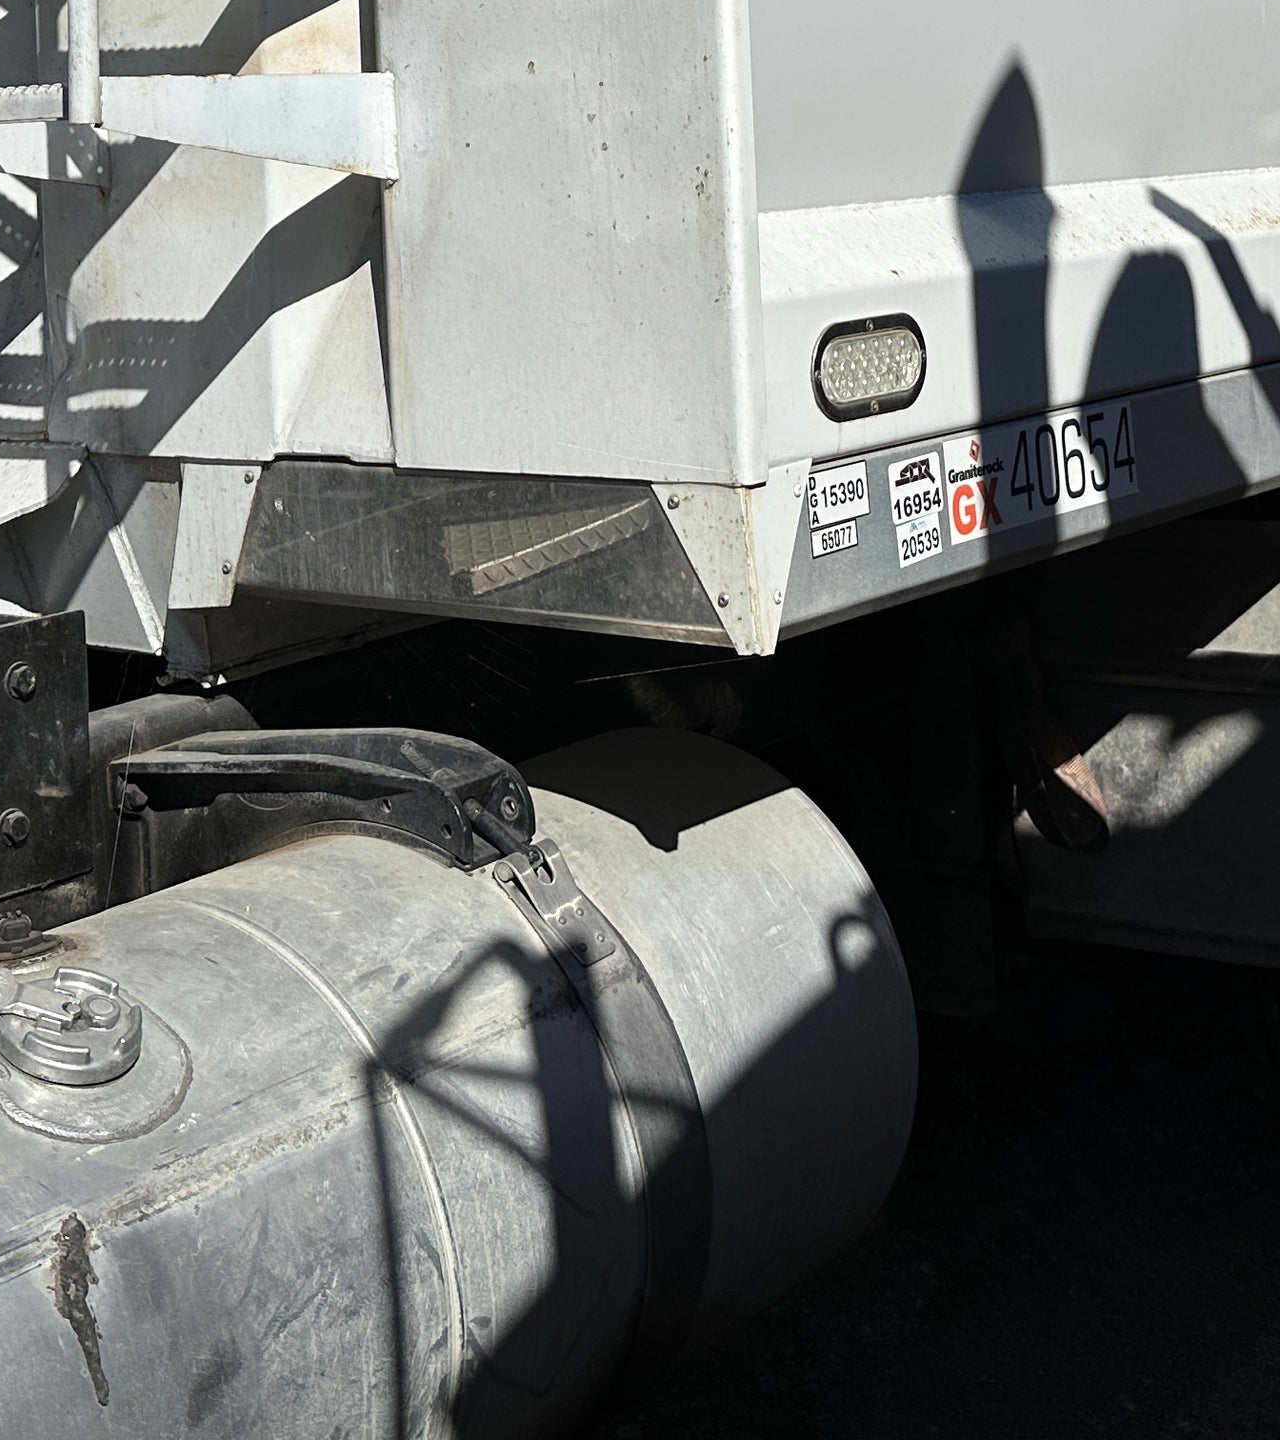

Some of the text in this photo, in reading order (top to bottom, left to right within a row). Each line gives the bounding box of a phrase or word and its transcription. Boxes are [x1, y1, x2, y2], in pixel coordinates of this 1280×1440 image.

[948, 457, 1004, 484] Graniterock
[952, 407, 1135, 536] GX 40654
[821, 478, 864, 508] 15390
[894, 487, 942, 520] 16954
[821, 526, 852, 551] 65077
[902, 527, 940, 561] 20539
